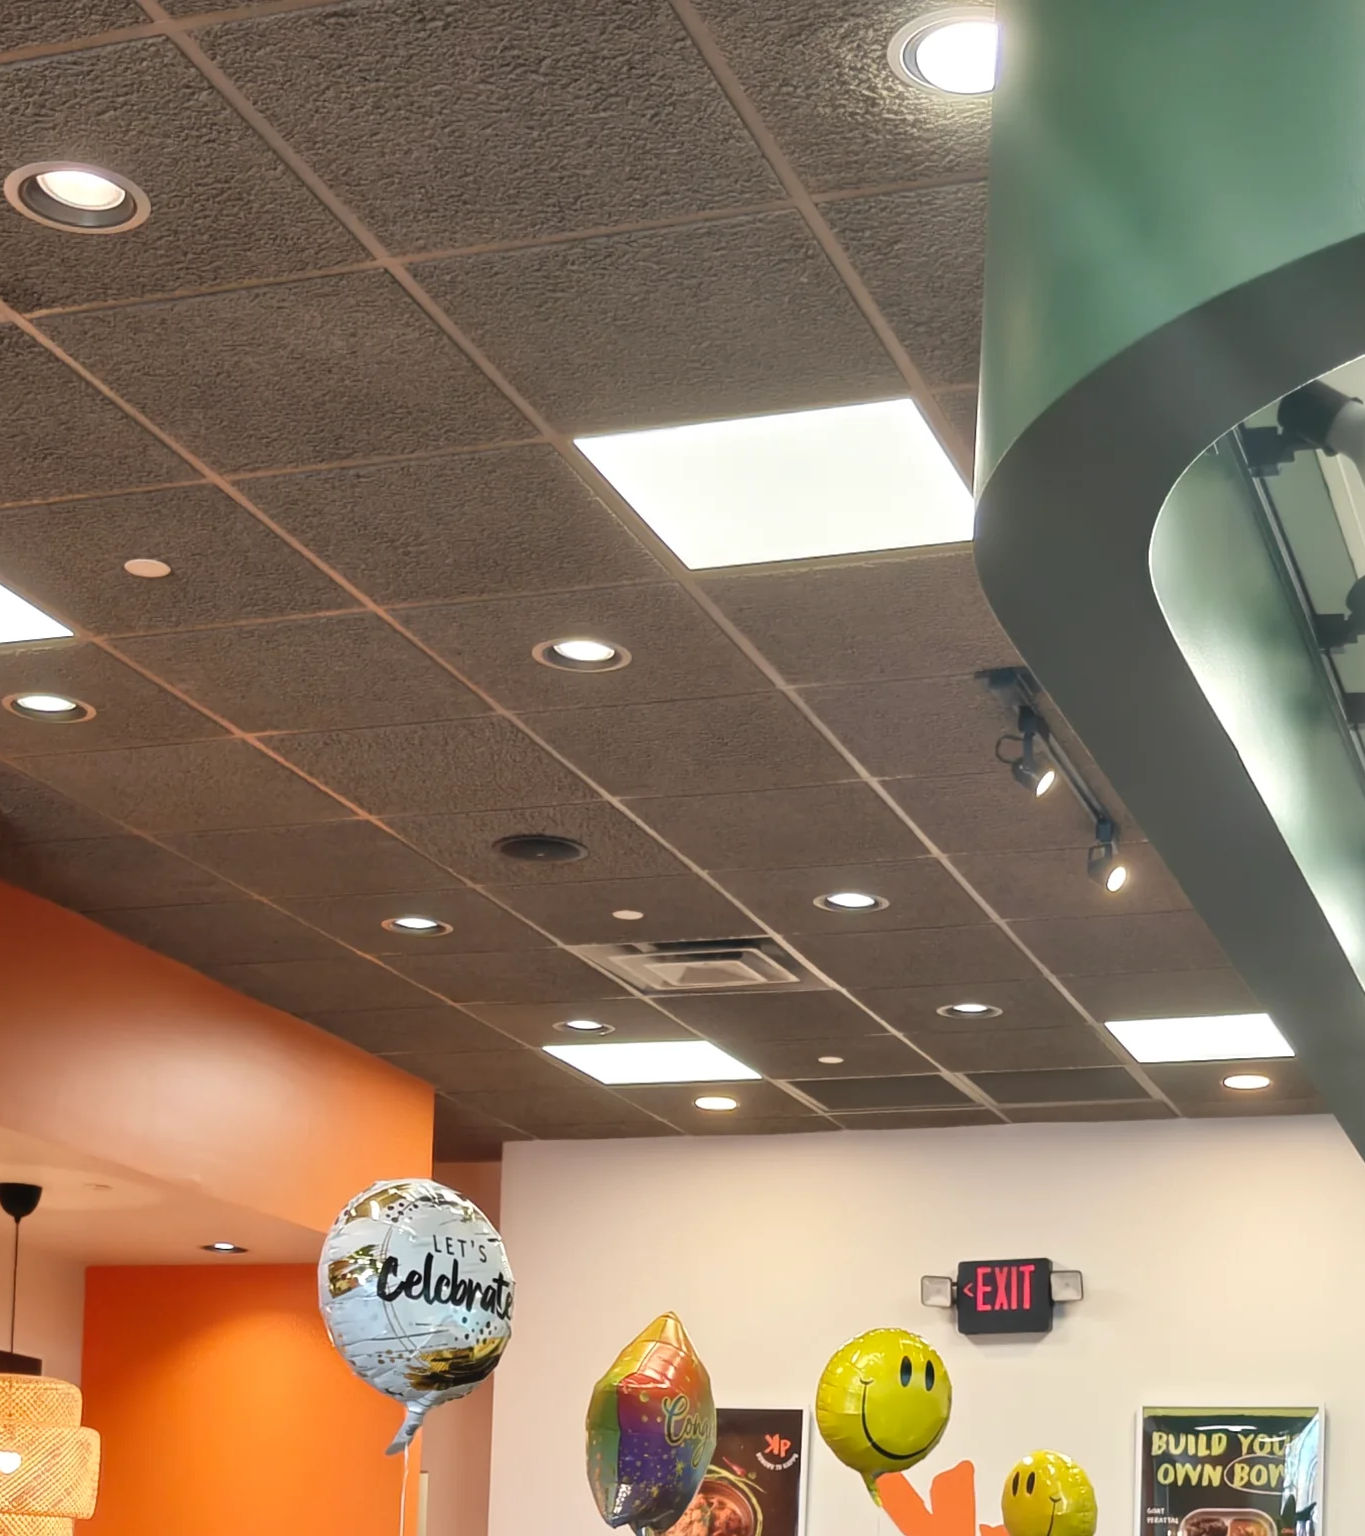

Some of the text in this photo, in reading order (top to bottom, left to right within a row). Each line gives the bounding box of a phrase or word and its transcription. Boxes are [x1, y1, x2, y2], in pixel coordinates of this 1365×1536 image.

[432, 1234, 488, 1263] LET'S
[976, 1264, 1035, 1311] EXIT
[662, 1393, 713, 1469] Cong
[1151, 1431, 1293, 1457] BUILD YOU
[1157, 1463, 1285, 1488] OWN BOW
